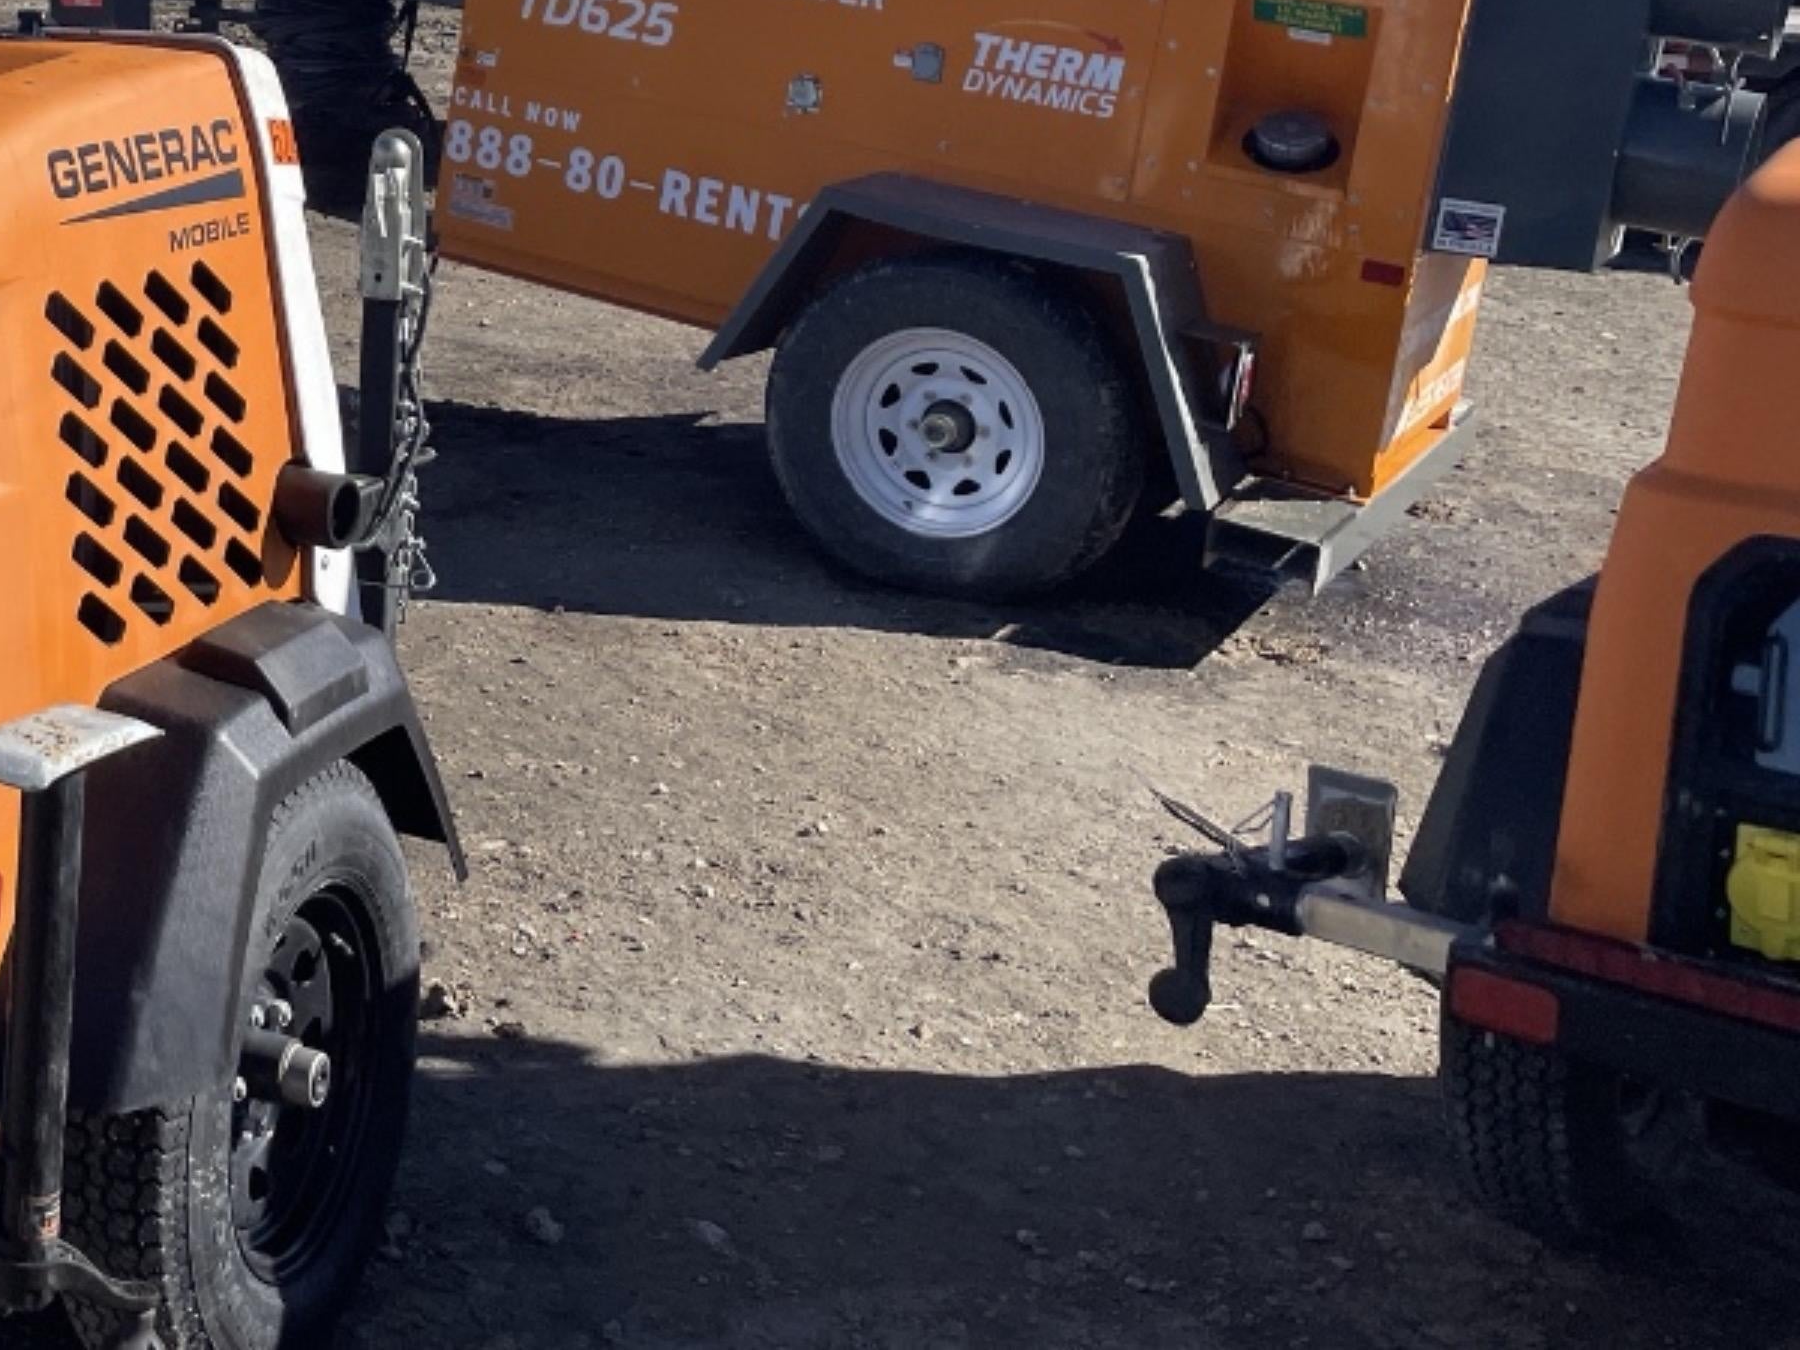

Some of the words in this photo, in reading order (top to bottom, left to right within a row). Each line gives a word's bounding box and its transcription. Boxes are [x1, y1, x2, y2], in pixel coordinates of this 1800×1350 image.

[972, 32, 1125, 92] THERM
[455, 87, 512, 118] CALL
[526, 101, 582, 133] NOW
[962, 70, 1117, 118] DYNAMICS
[47, 119, 238, 199] GENERAC
[446, 120, 806, 240] 888-80-RENT
[169, 212, 250, 252] MOBILE
